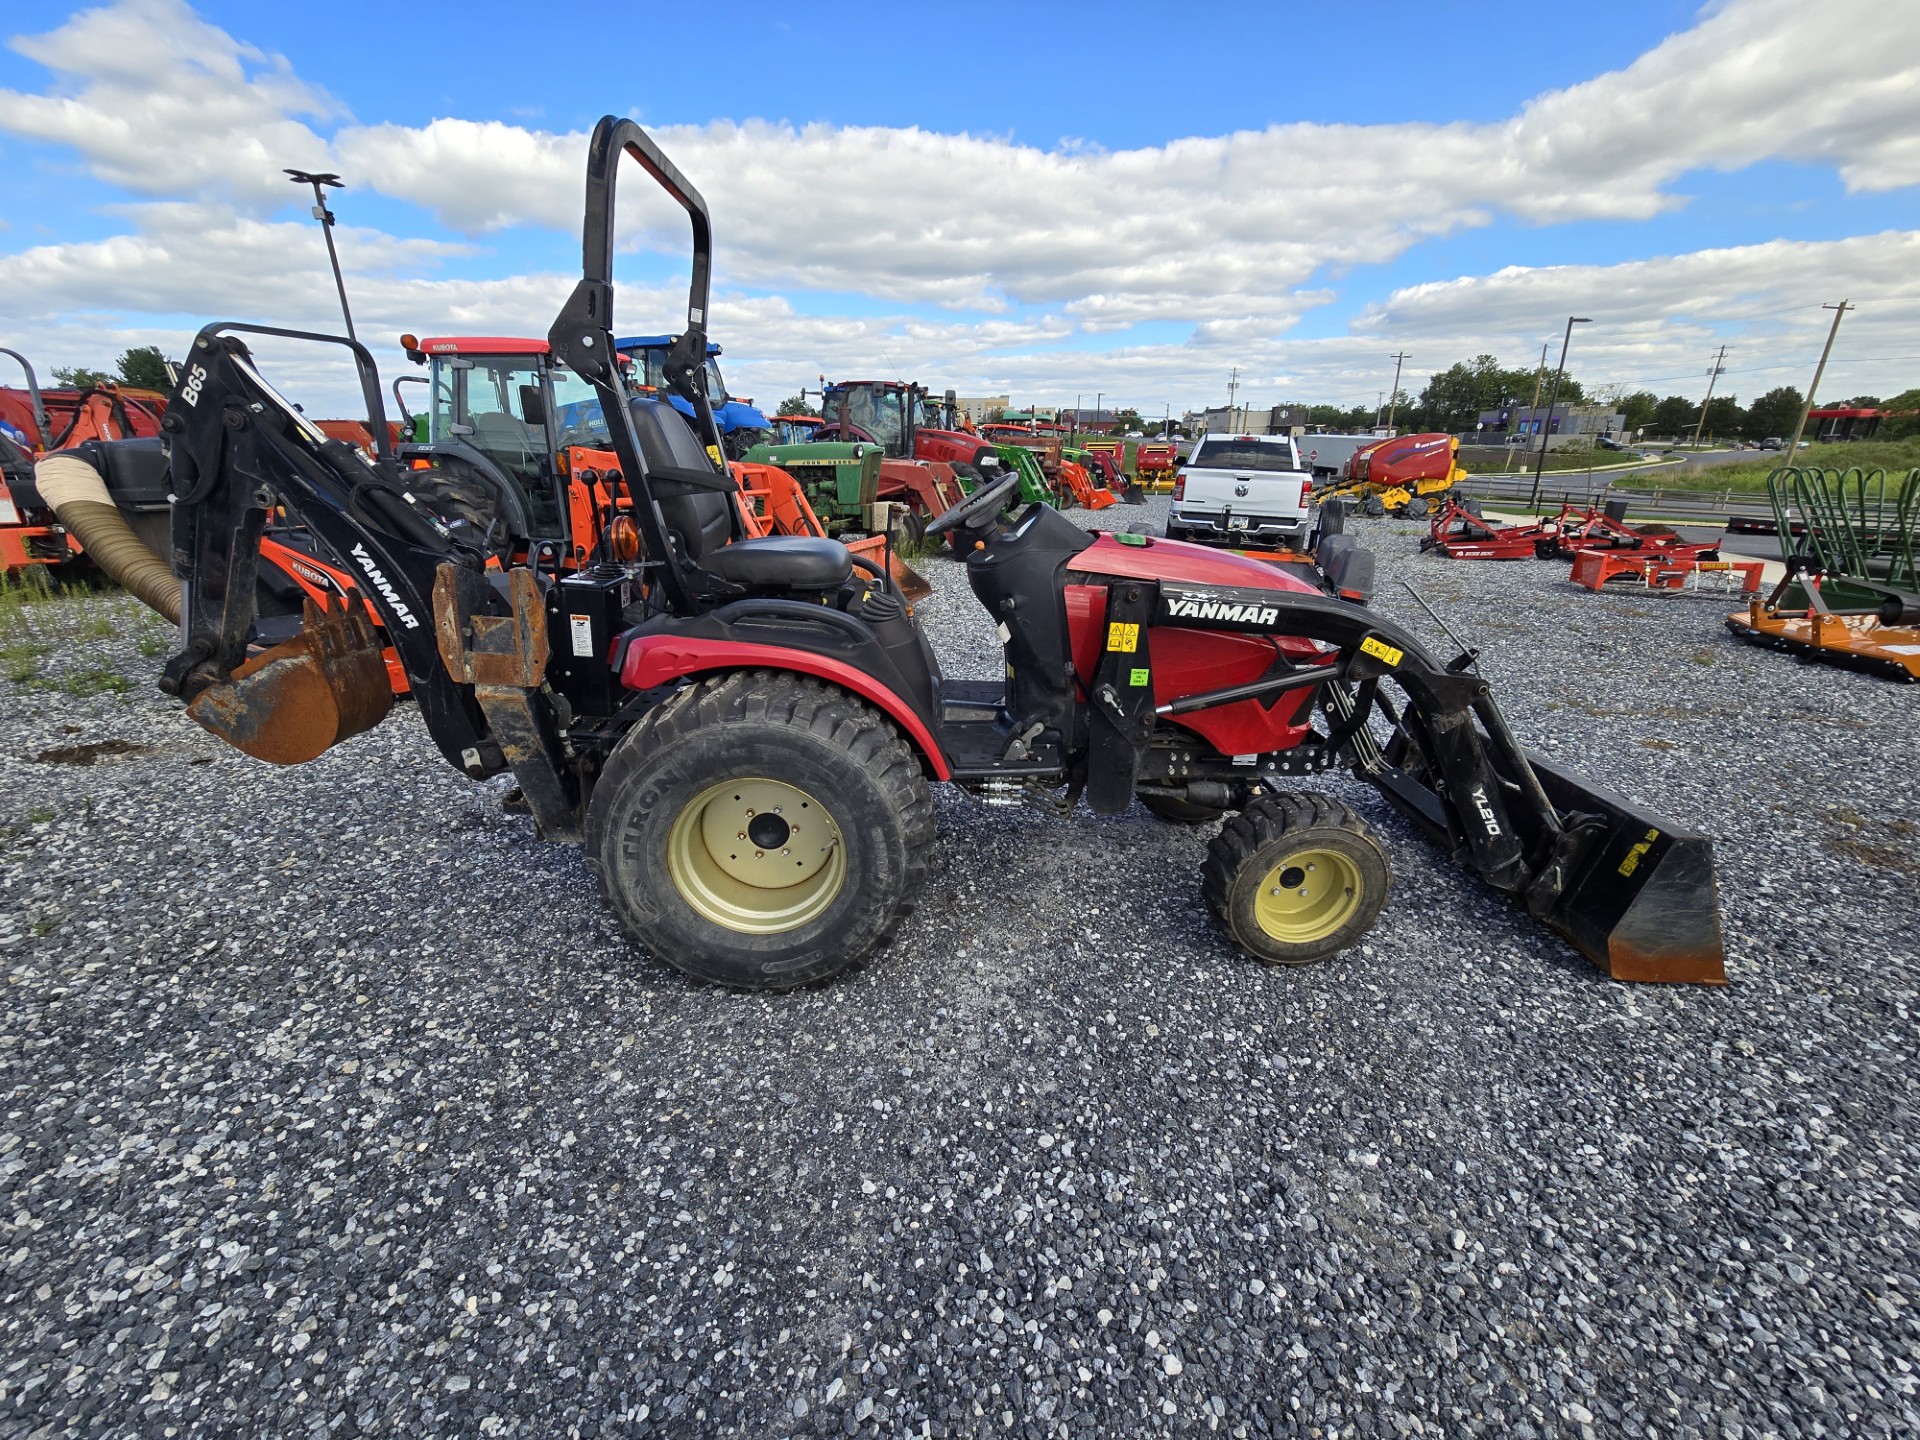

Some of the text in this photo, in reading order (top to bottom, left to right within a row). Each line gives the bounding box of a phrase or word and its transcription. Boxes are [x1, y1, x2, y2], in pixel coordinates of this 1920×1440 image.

[181, 363, 207, 407] B65
[292, 561, 329, 588] KUBOTA
[350, 542, 420, 629] YANMAR
[1167, 599, 1279, 625] YANMAR
[1472, 787, 1502, 836] YL210
